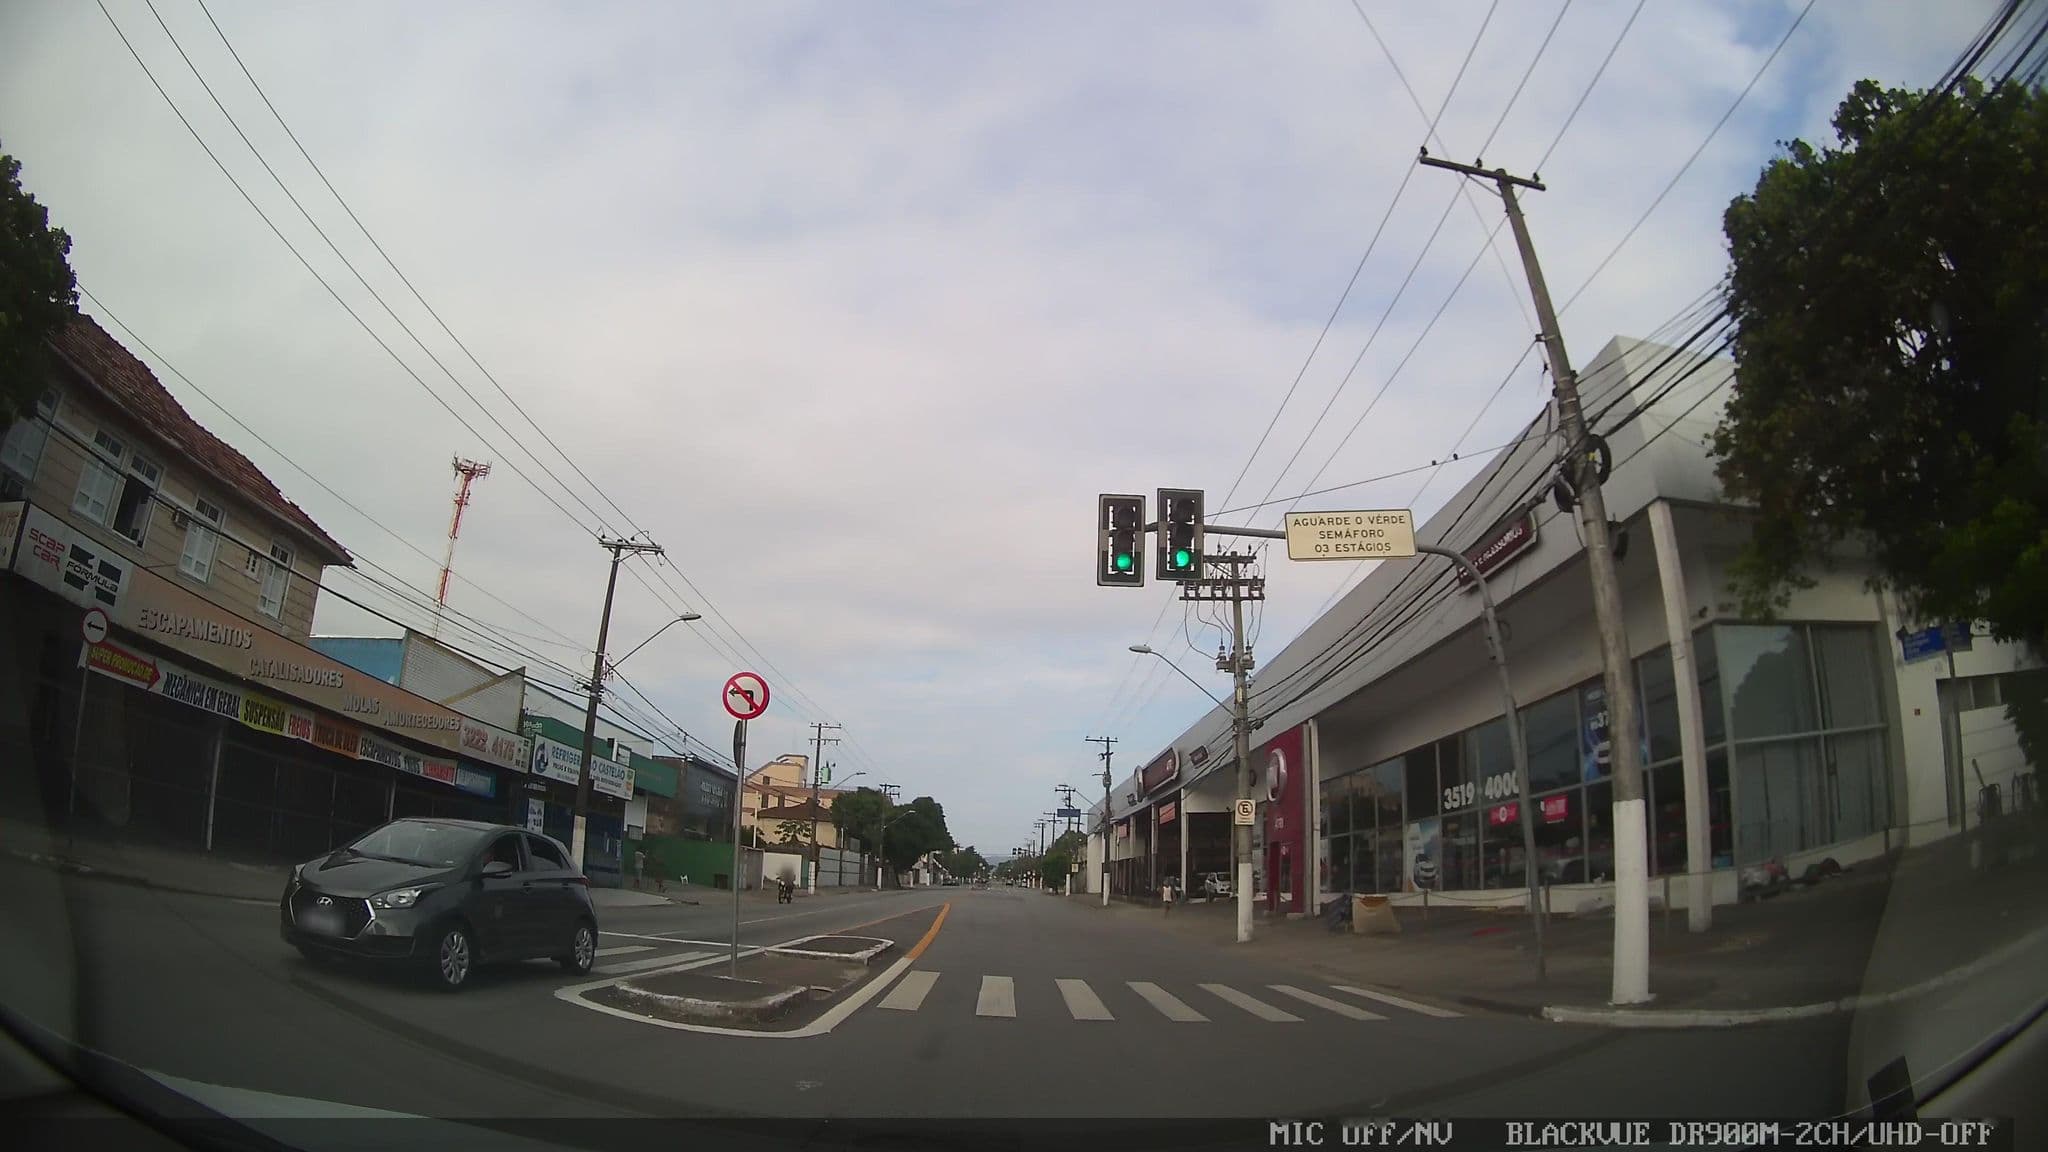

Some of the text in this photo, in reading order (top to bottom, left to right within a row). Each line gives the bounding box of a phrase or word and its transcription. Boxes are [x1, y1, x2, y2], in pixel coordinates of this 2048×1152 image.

[1293, 514, 1406, 527] AGUARDE O VERDE
[1319, 528, 1385, 540] SEMÁFORO
[1314, 541, 1392, 553] 03 ESTÁGIOS
[138, 609, 253, 651] ESCAPAMENTOS
[250, 657, 344, 689] CATALISADORES
[162, 671, 240, 718] MECÂNICA EM GERAL
[344, 695, 380, 715] MOLAS
[244, 698, 286, 732] SUSPENSÃO
[384, 710, 461, 732] AMORTECEDORES
[1444, 782, 1475, 810] 3519
